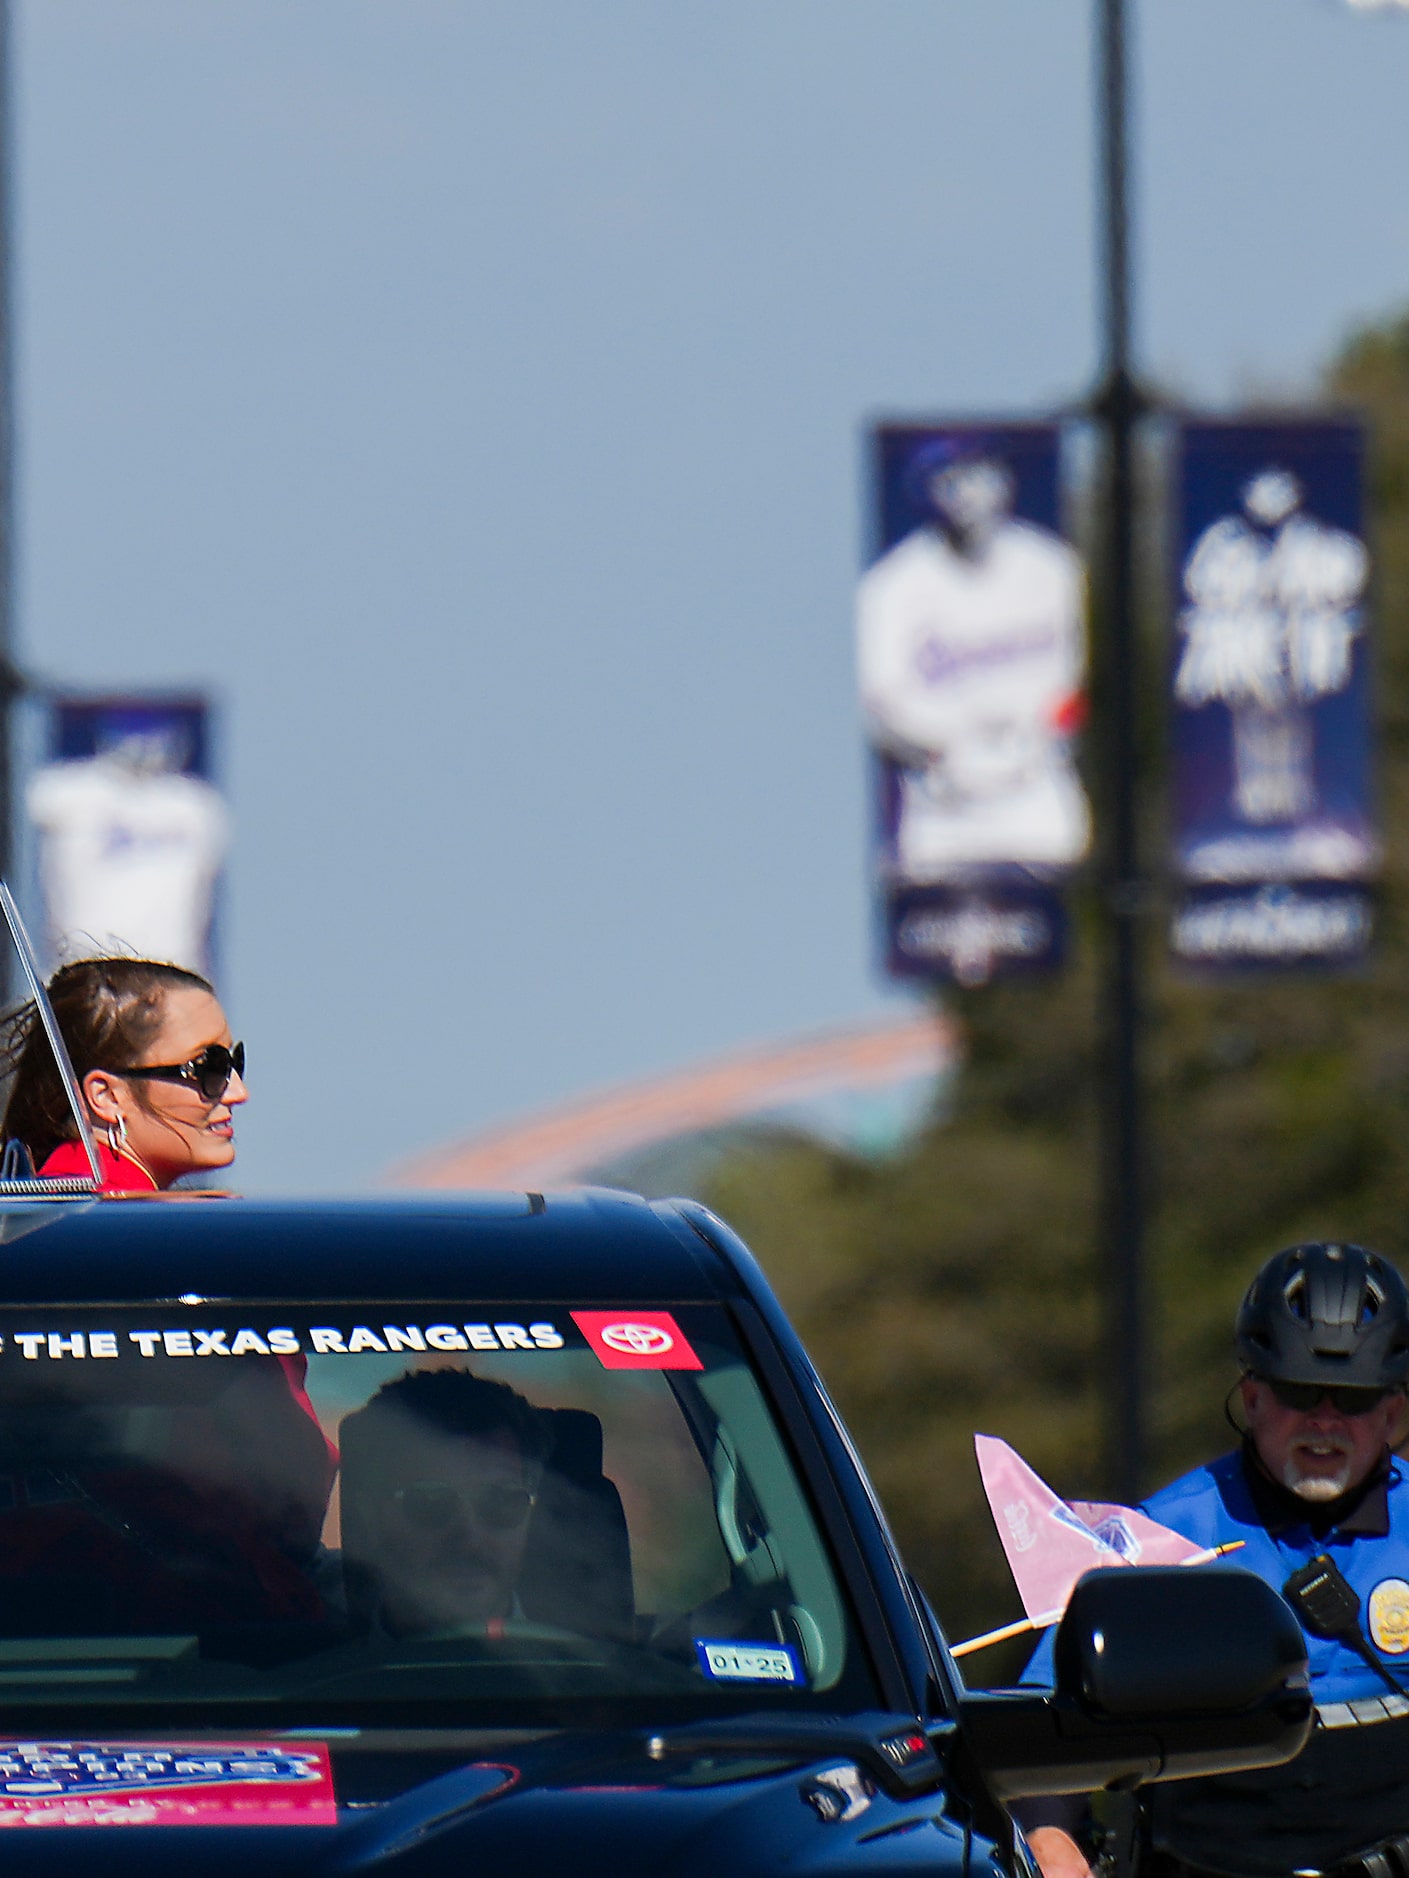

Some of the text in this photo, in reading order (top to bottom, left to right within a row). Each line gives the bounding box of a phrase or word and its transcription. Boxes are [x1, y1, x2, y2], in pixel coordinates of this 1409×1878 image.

[13, 1332, 120, 1360] THE
[129, 1328, 301, 1357] TEXAS
[308, 1325, 564, 1355] RANGERS
